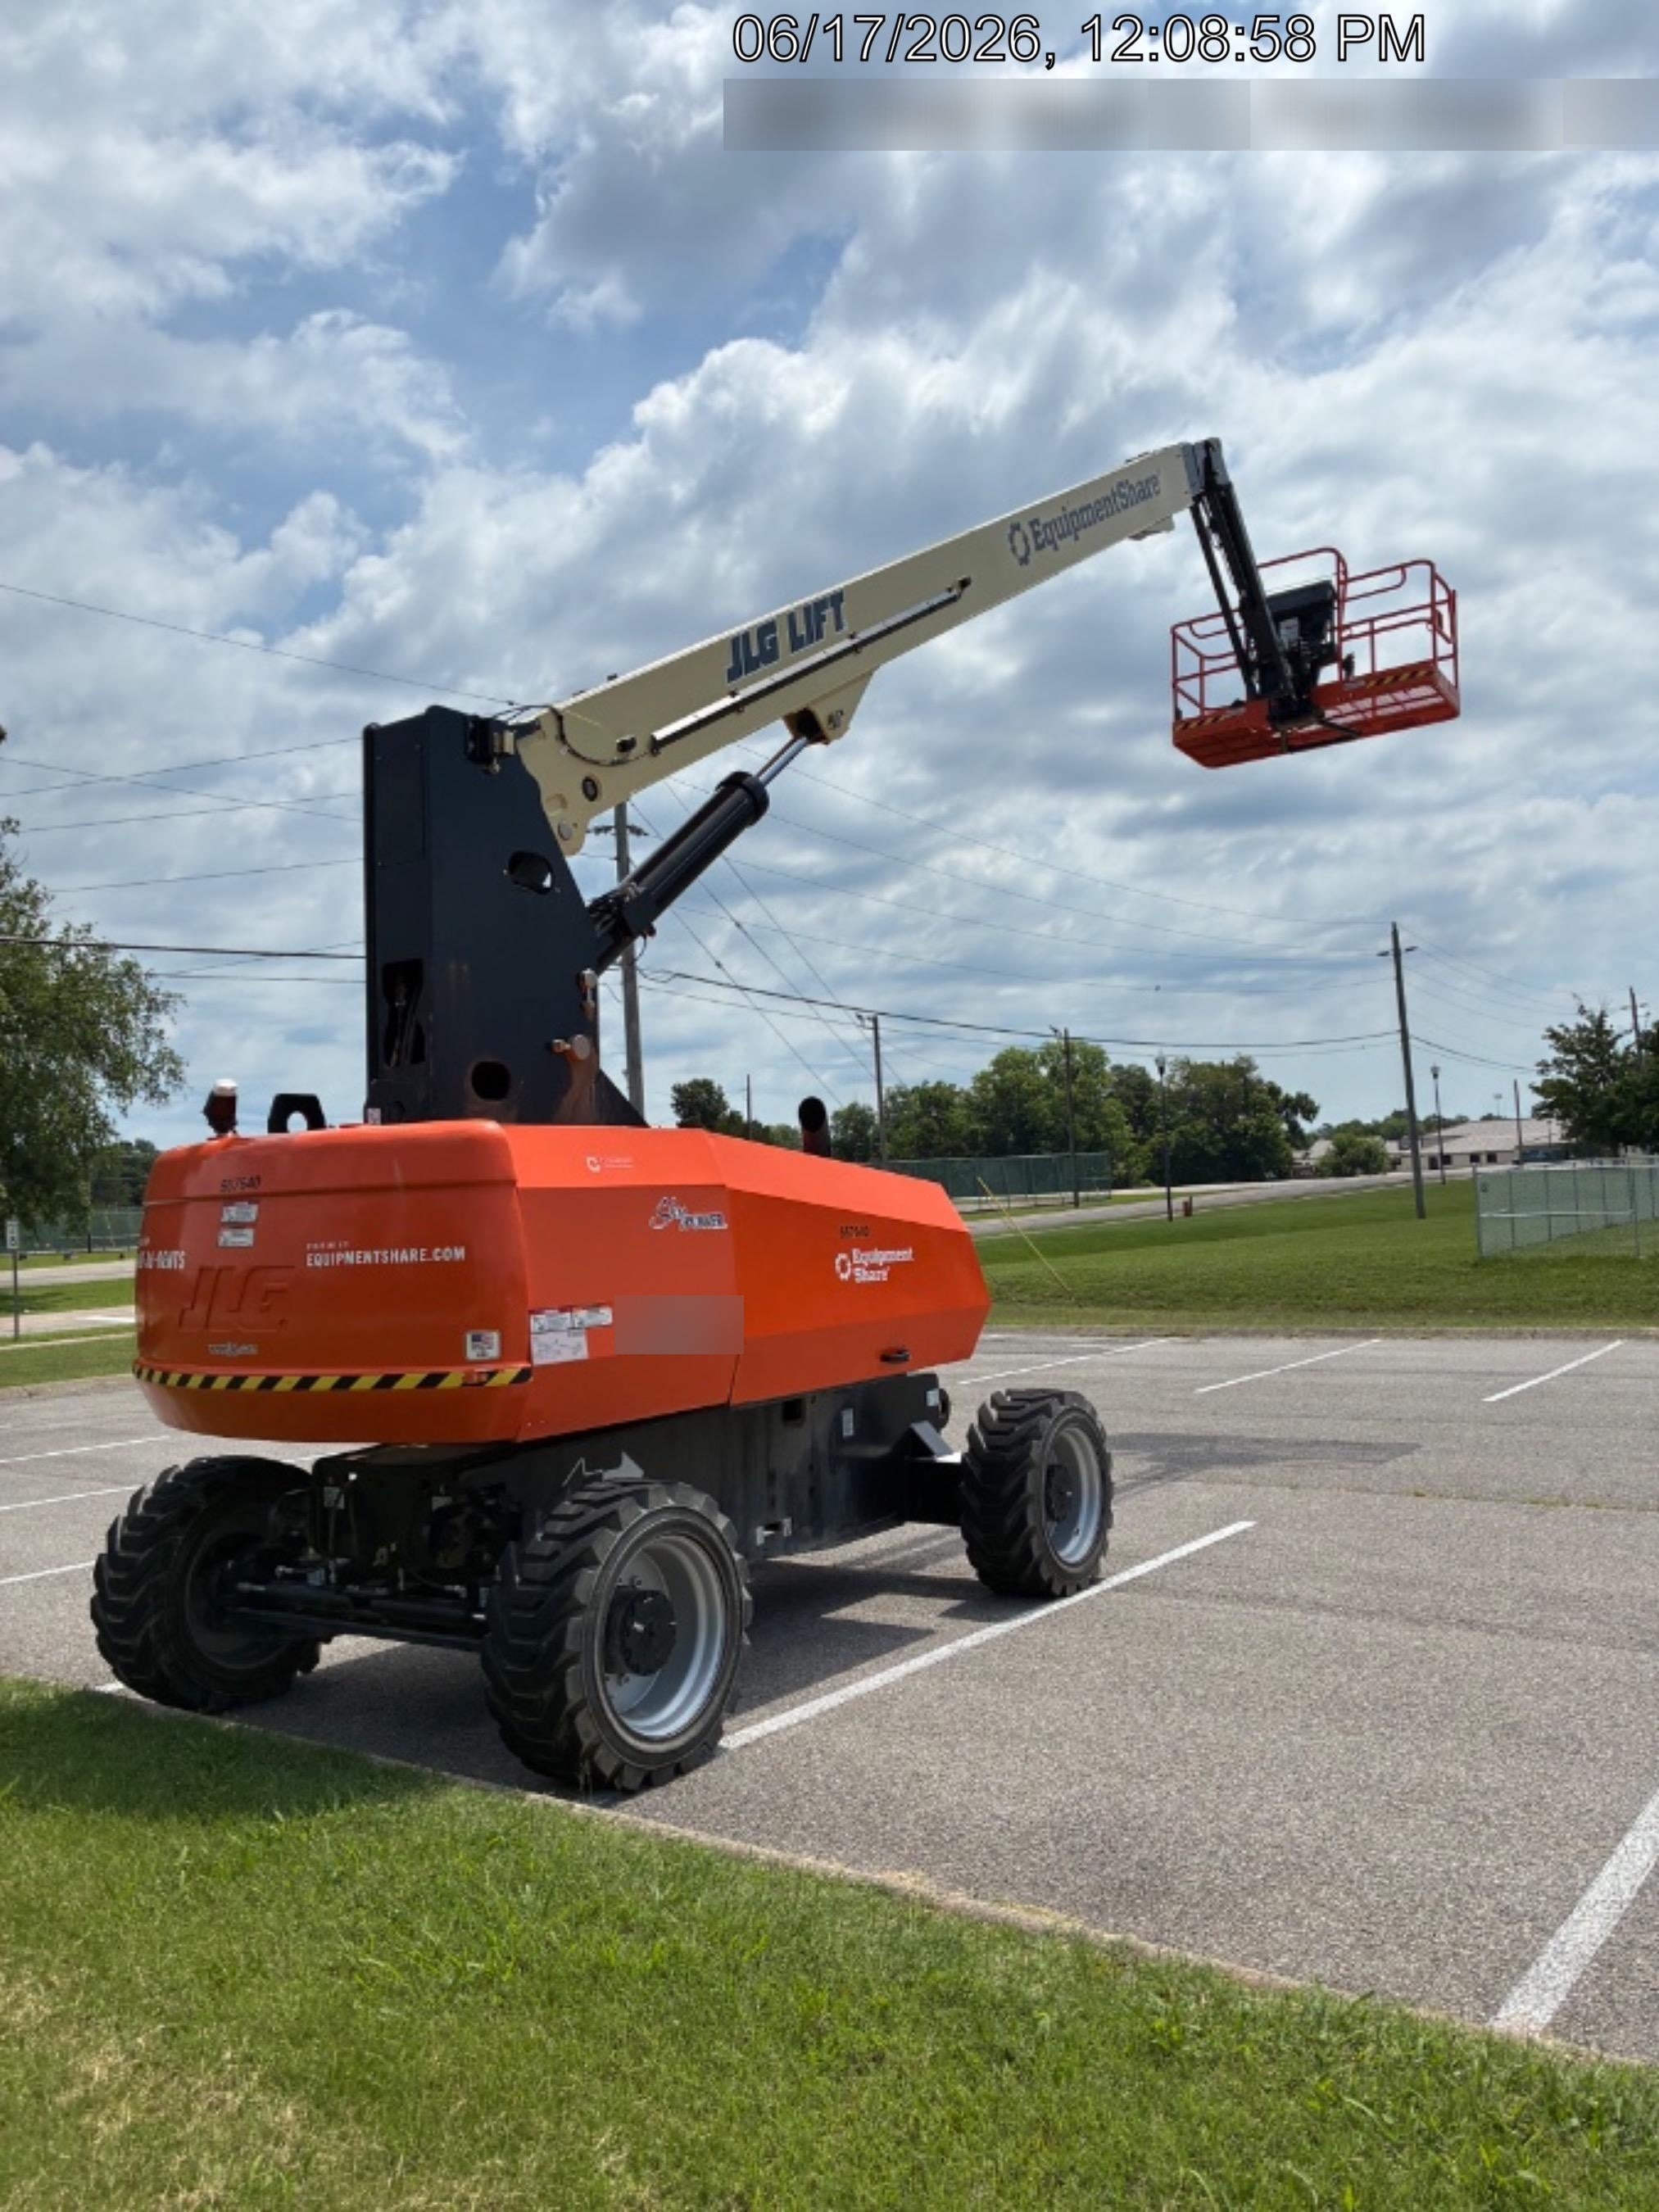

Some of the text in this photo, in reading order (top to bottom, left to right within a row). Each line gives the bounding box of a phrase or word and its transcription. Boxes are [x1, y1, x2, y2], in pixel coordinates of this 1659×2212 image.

[1029, 474, 1160, 551] EquipmentShare
[727, 589, 844, 683] JLG LIFT
[306, 1245, 465, 1267] EQUIPMENTSHARE.COM
[852, 1246, 914, 1267] Equipment
[854, 1267, 890, 1284] Share
